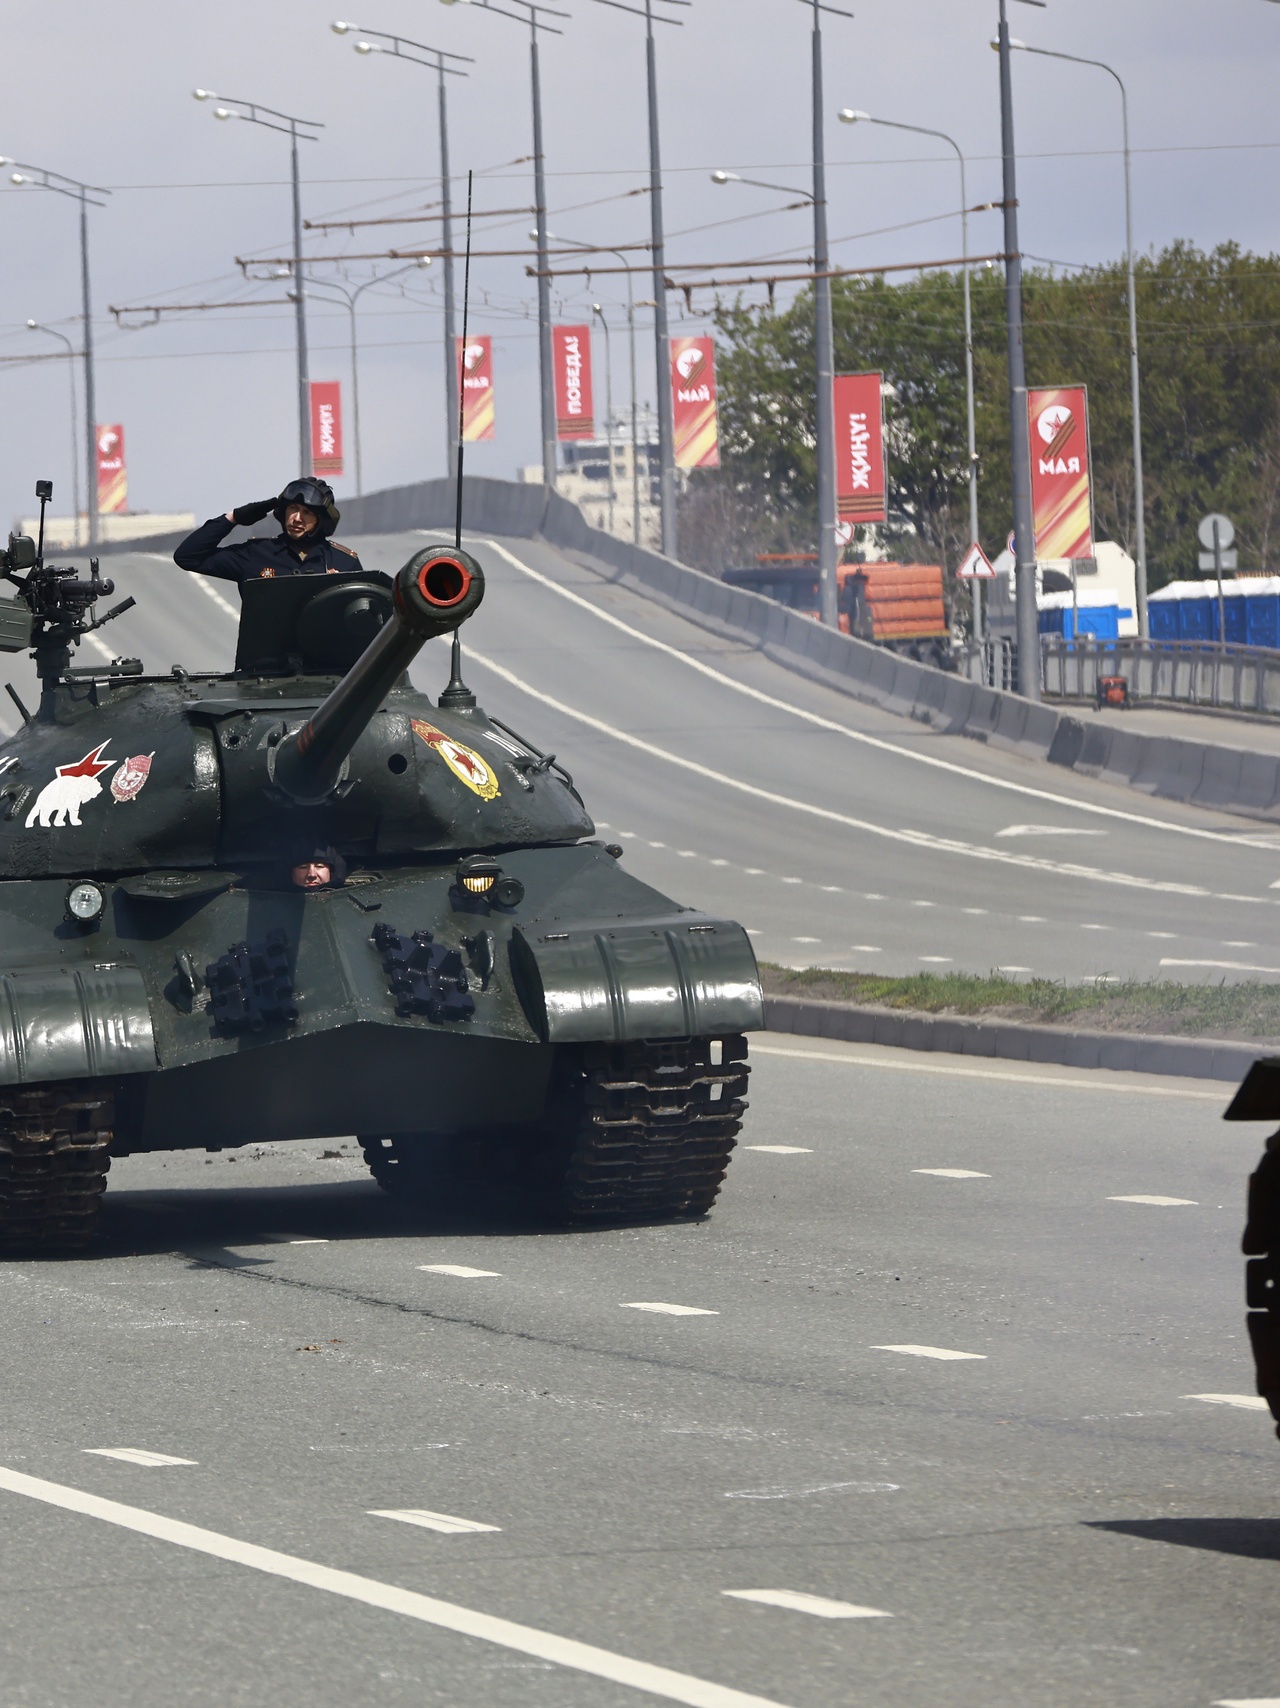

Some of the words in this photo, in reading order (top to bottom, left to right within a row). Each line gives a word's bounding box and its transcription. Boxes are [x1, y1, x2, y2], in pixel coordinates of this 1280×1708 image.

[563, 335, 582, 414] ПОБЕДА!
[677, 384, 710, 403] МАЙ
[1038, 456, 1080, 475] МАЯ
